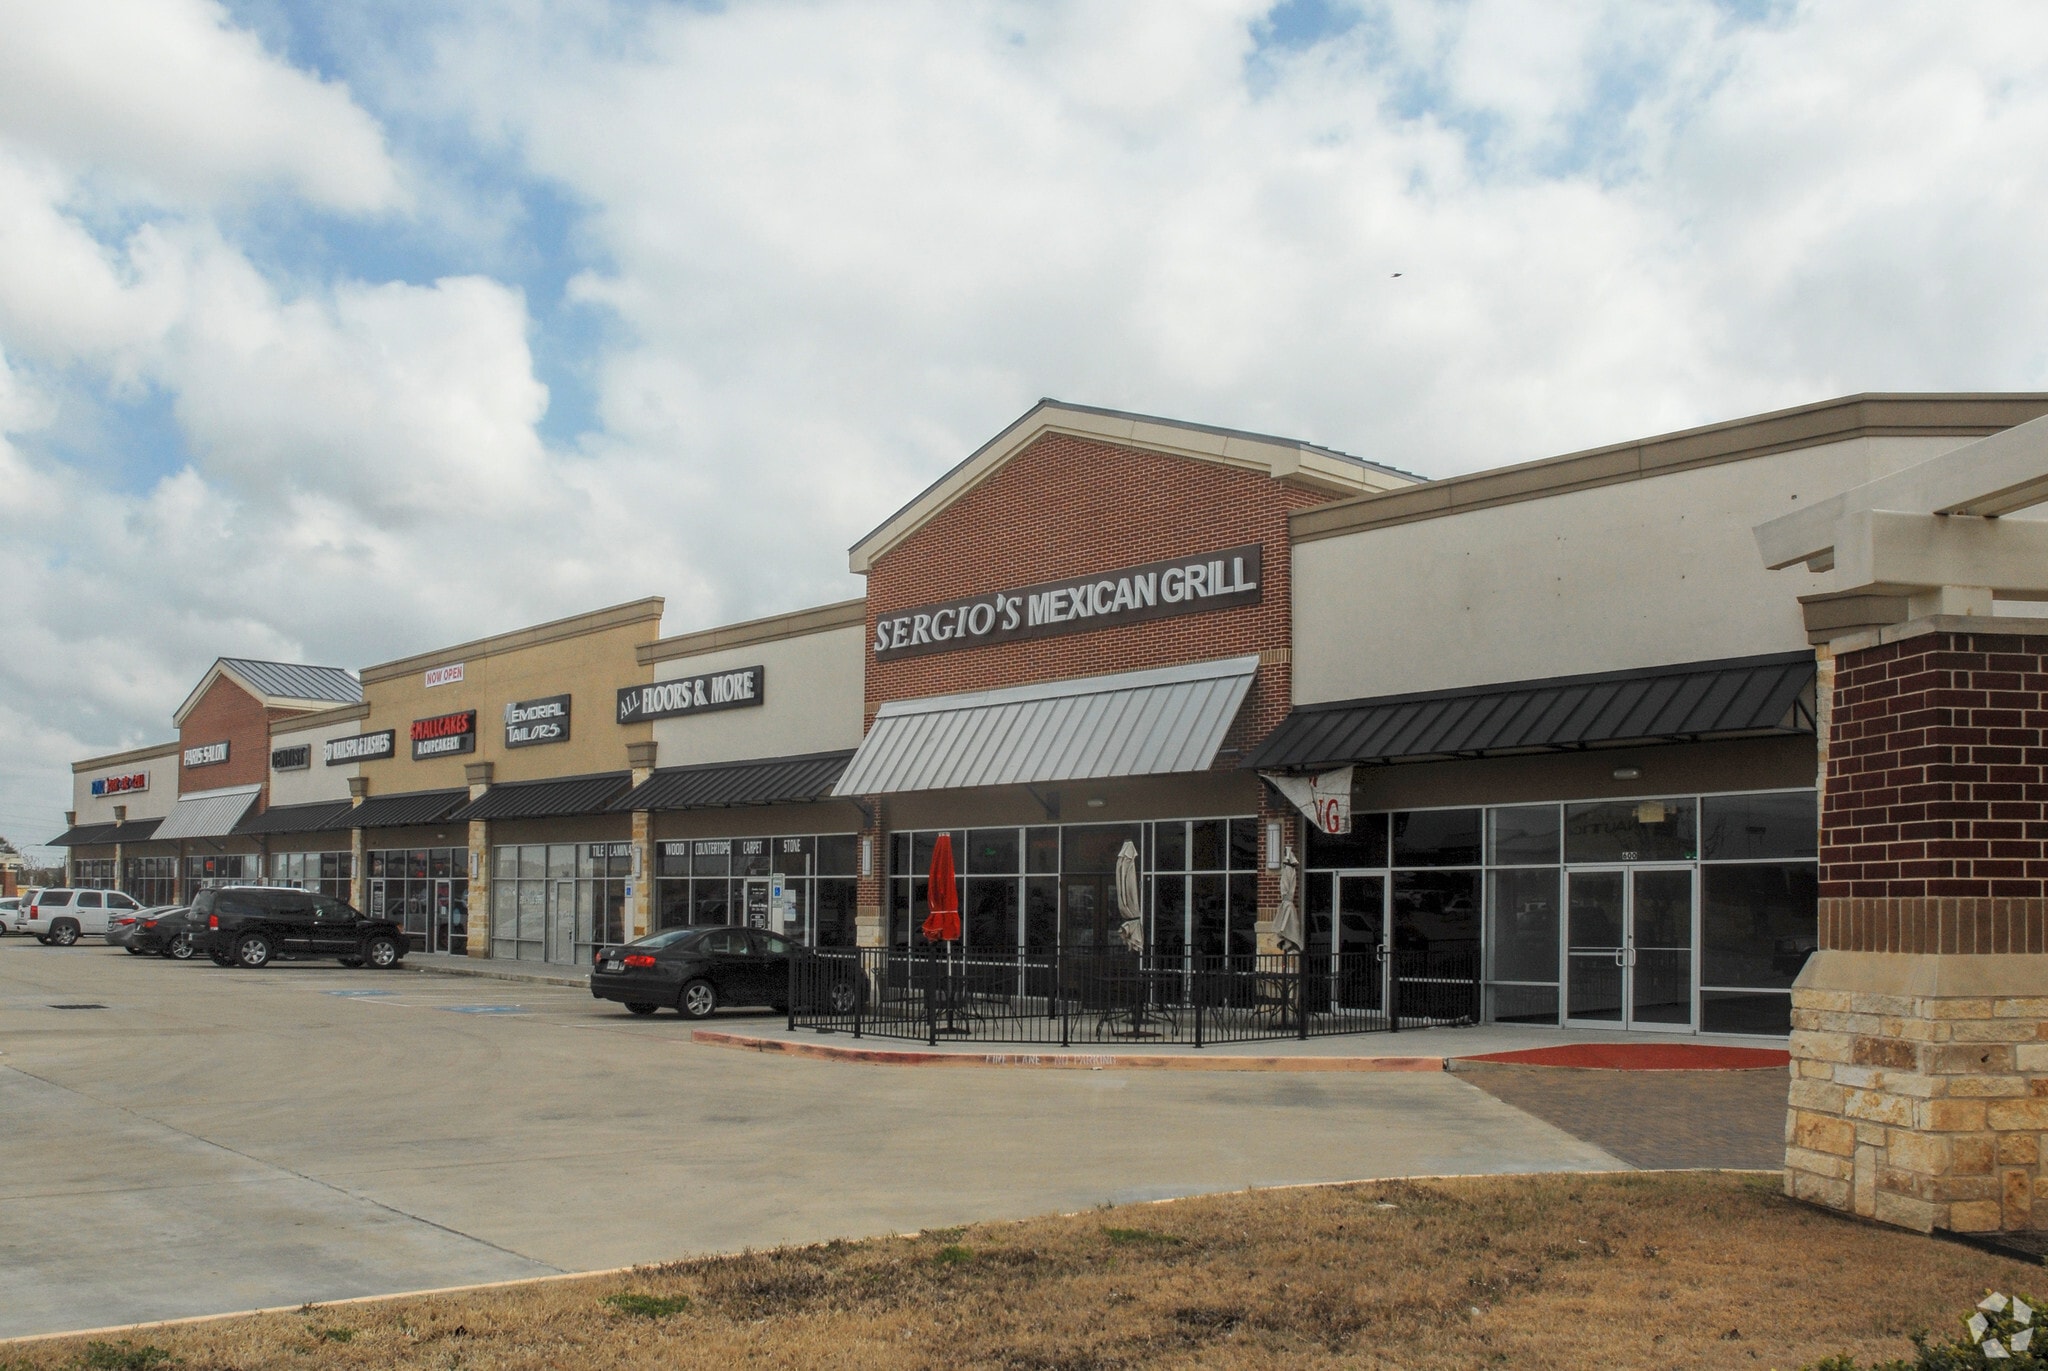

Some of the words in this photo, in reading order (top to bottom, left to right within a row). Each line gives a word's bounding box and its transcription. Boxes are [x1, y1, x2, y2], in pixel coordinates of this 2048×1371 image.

[874, 593, 1023, 652] SERGIO'S
[1028, 572, 1157, 627] MEXICAN
[1161, 557, 1257, 603] GRILL
[427, 671, 442, 685] NOW
[444, 666, 462, 681] OPEN
[620, 690, 640, 720] ALL
[642, 681, 692, 714] FLOORS
[694, 679, 709, 706] &
[711, 671, 755, 704] MORE
[410, 712, 469, 740] SMALLCAKES
[506, 723, 560, 742] TAILORS
[203, 743, 227, 763] SALON
[364, 733, 390, 755] LASHES
[418, 741, 425, 755] A
[592, 844, 604, 857] TILE
[665, 842, 685, 856] WOOD
[695, 841, 731, 855] COUNTERTOPS
[743, 840, 763, 854] CARPET
[783, 839, 801, 853] STONE
[1622, 852, 1637, 860] 600
[985, 1055, 1006, 1065] FIRE
[1014, 1055, 1041, 1065] LANE
[1054, 1055, 1069, 1066] NO
[1074, 1055, 1117, 1066] PARKING
